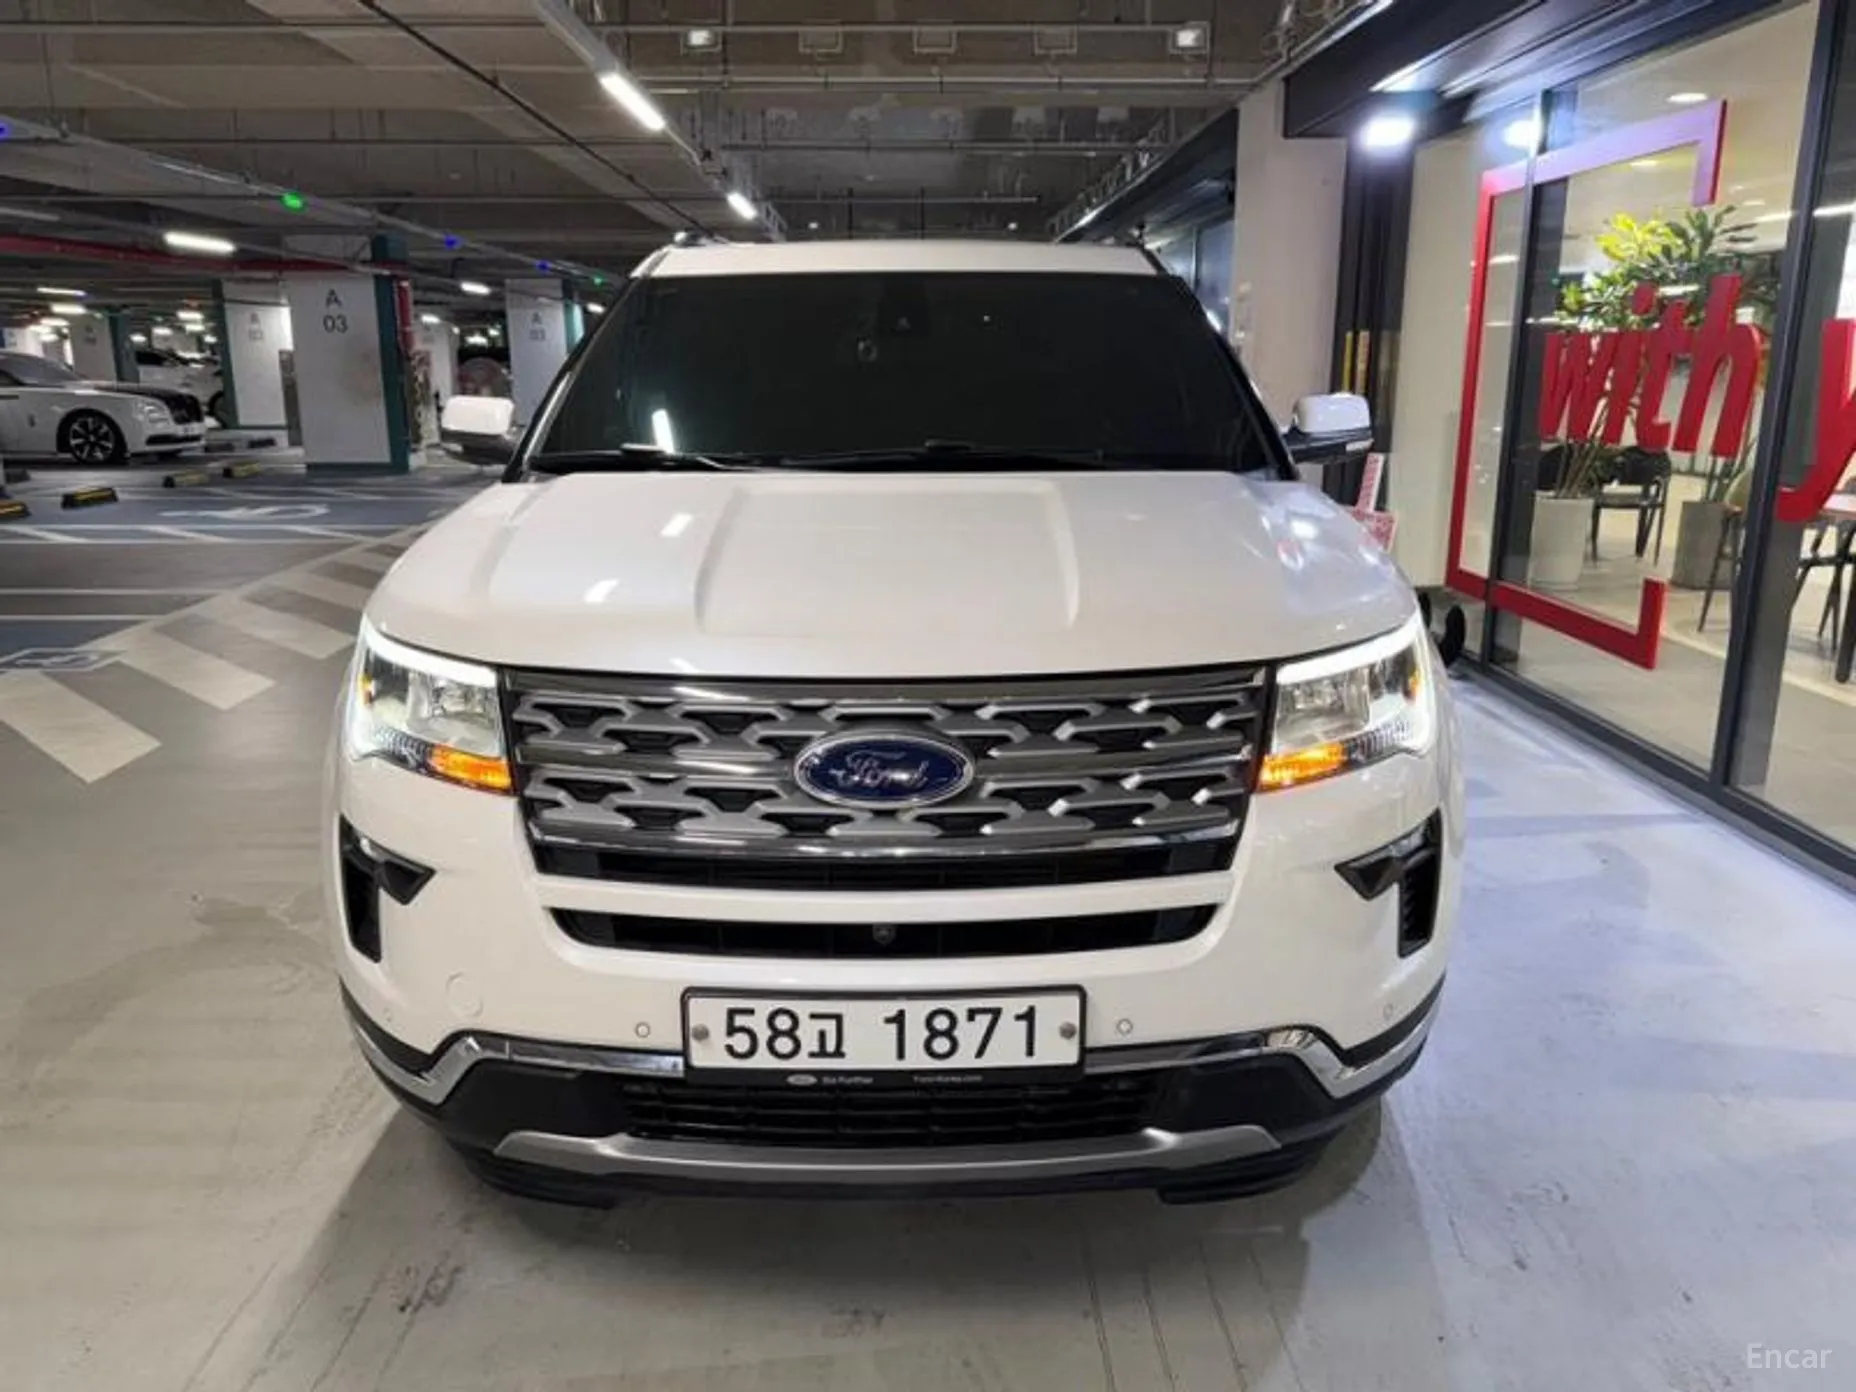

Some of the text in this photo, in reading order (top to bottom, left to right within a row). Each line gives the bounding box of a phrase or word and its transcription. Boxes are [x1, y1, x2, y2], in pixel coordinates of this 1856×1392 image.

[326, 289, 342, 308] A
[323, 314, 349, 334] 03
[1540, 274, 1763, 457] with
[829, 752, 930, 788] Ford
[724, 1004, 1038, 1060] 58고 1871
